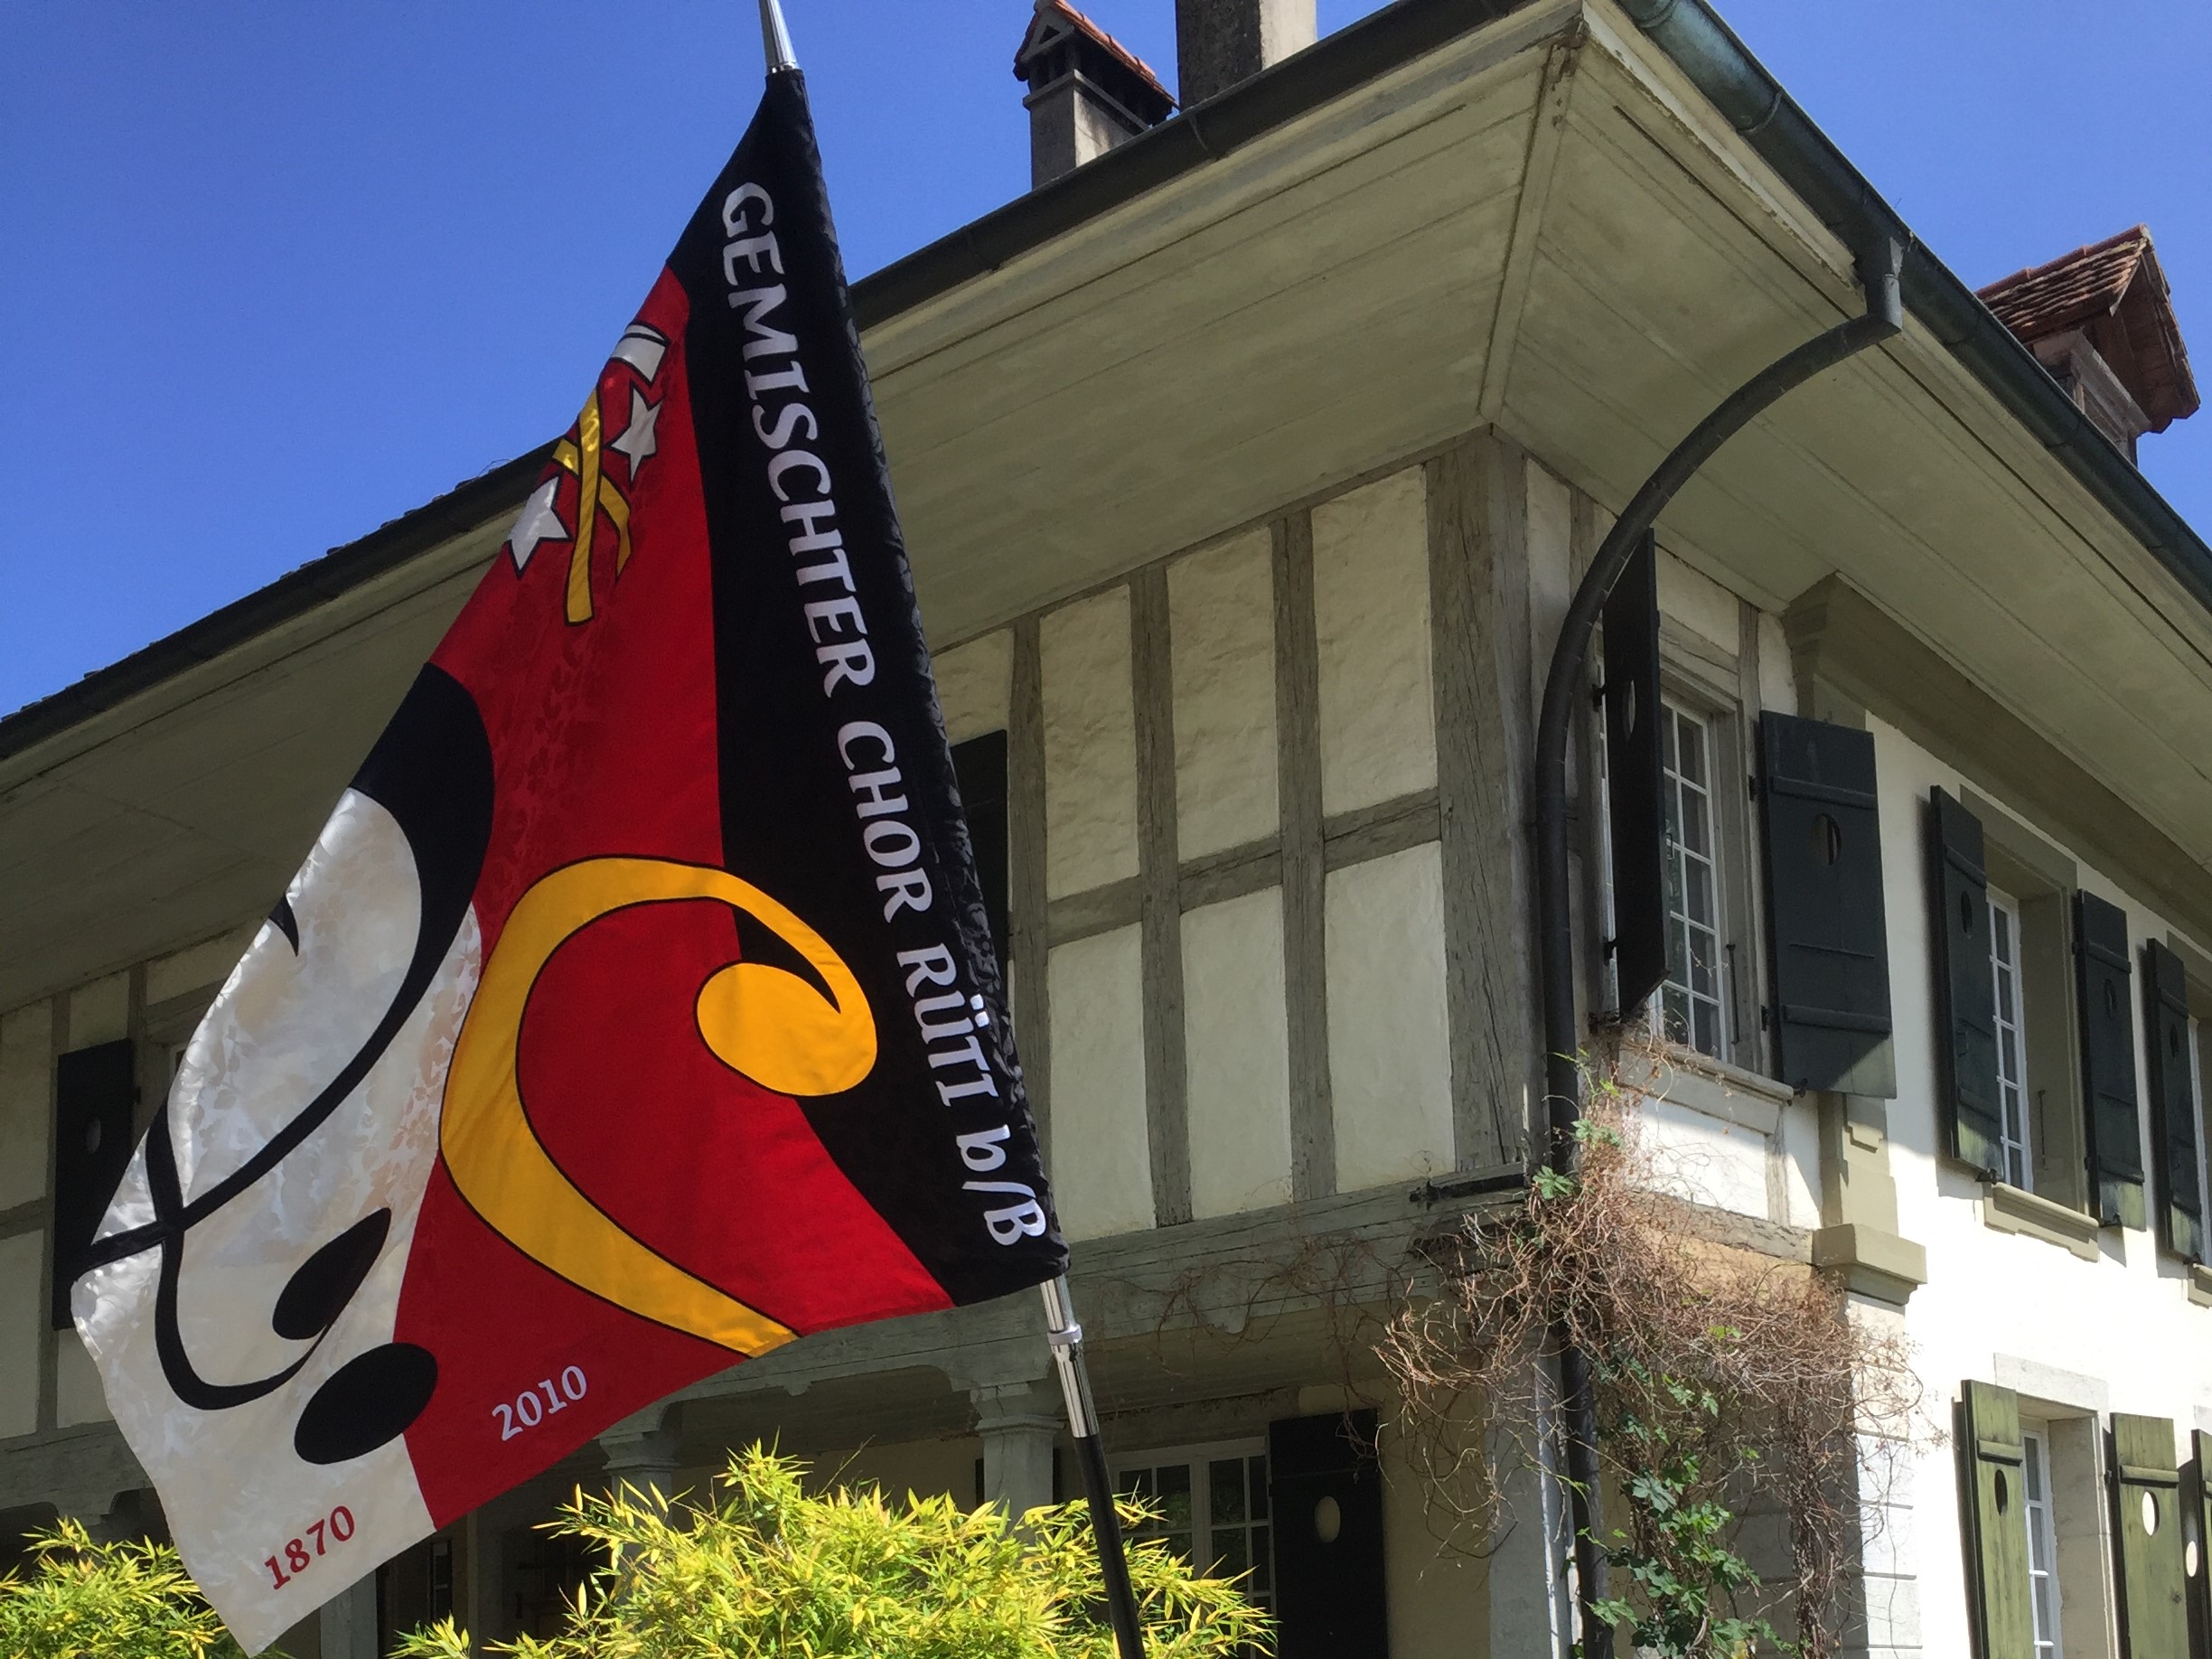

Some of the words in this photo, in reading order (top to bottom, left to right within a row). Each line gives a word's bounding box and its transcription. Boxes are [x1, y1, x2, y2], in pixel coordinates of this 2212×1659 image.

[722, 182, 876, 698] GEMISCHTER
[837, 720, 933, 923] CHOR
[896, 942, 999, 1108] RÜTI
[955, 1124, 1046, 1246] b/B
[492, 1365, 587, 1442] 2010
[264, 1505, 355, 1590] 1870
